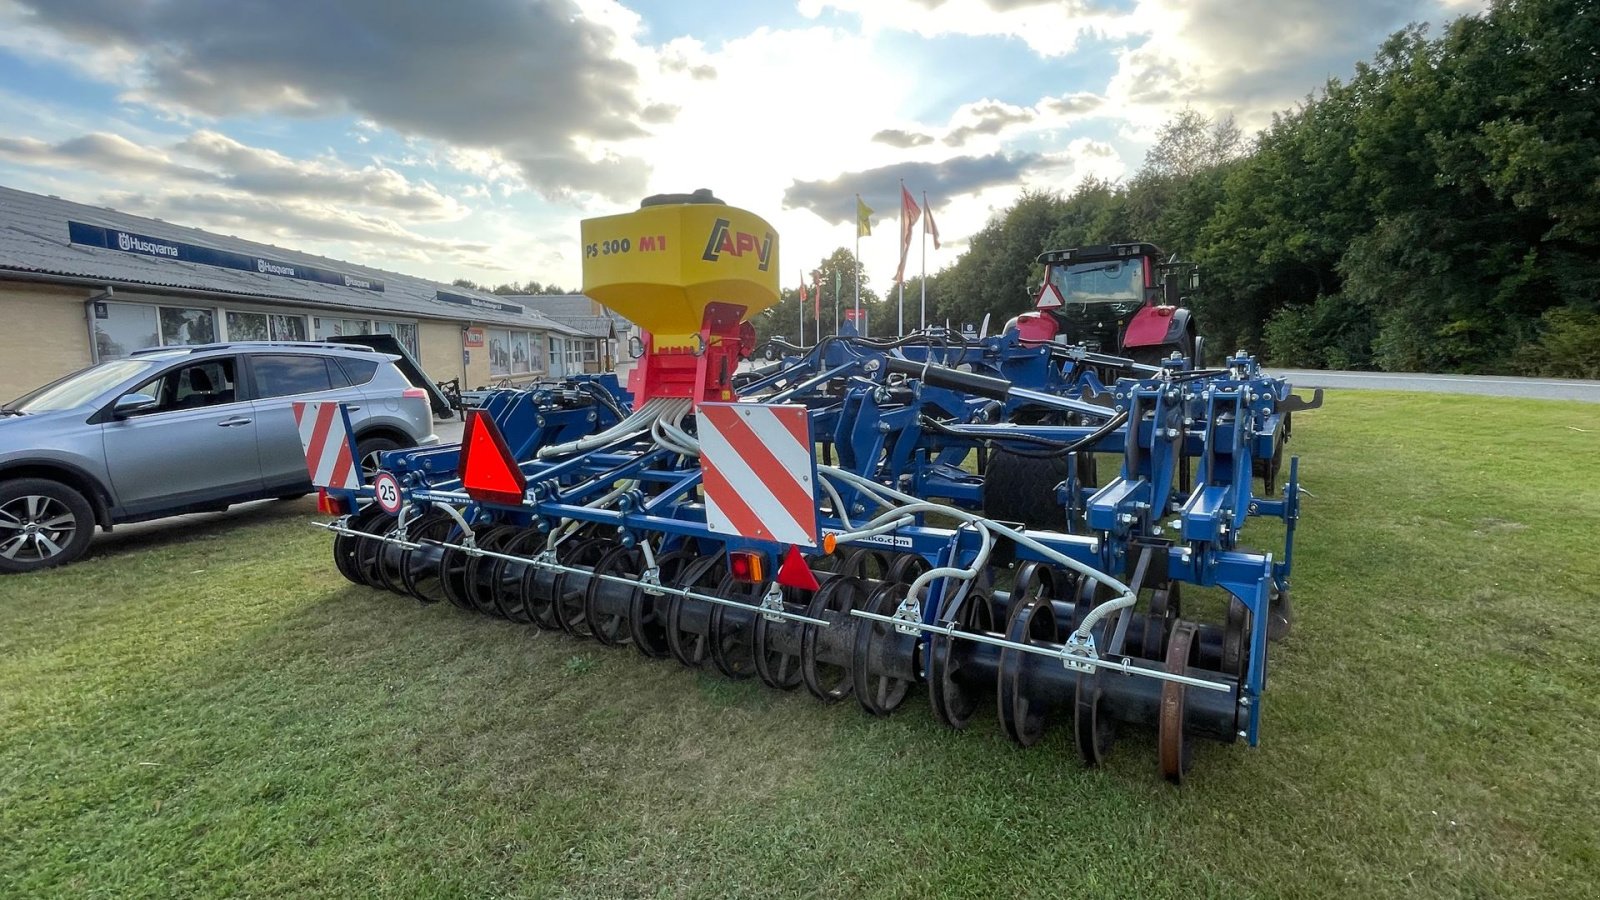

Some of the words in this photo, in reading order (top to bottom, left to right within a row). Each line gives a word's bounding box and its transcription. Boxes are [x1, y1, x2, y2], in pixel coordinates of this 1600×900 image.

[129, 236, 178, 257] Husqvarna
[586, 243, 598, 259] PS
[602, 238, 631, 255] 300
[639, 235, 666, 252] M1
[264, 262, 294, 275] Husqvarna
[380, 484, 396, 501] 25
